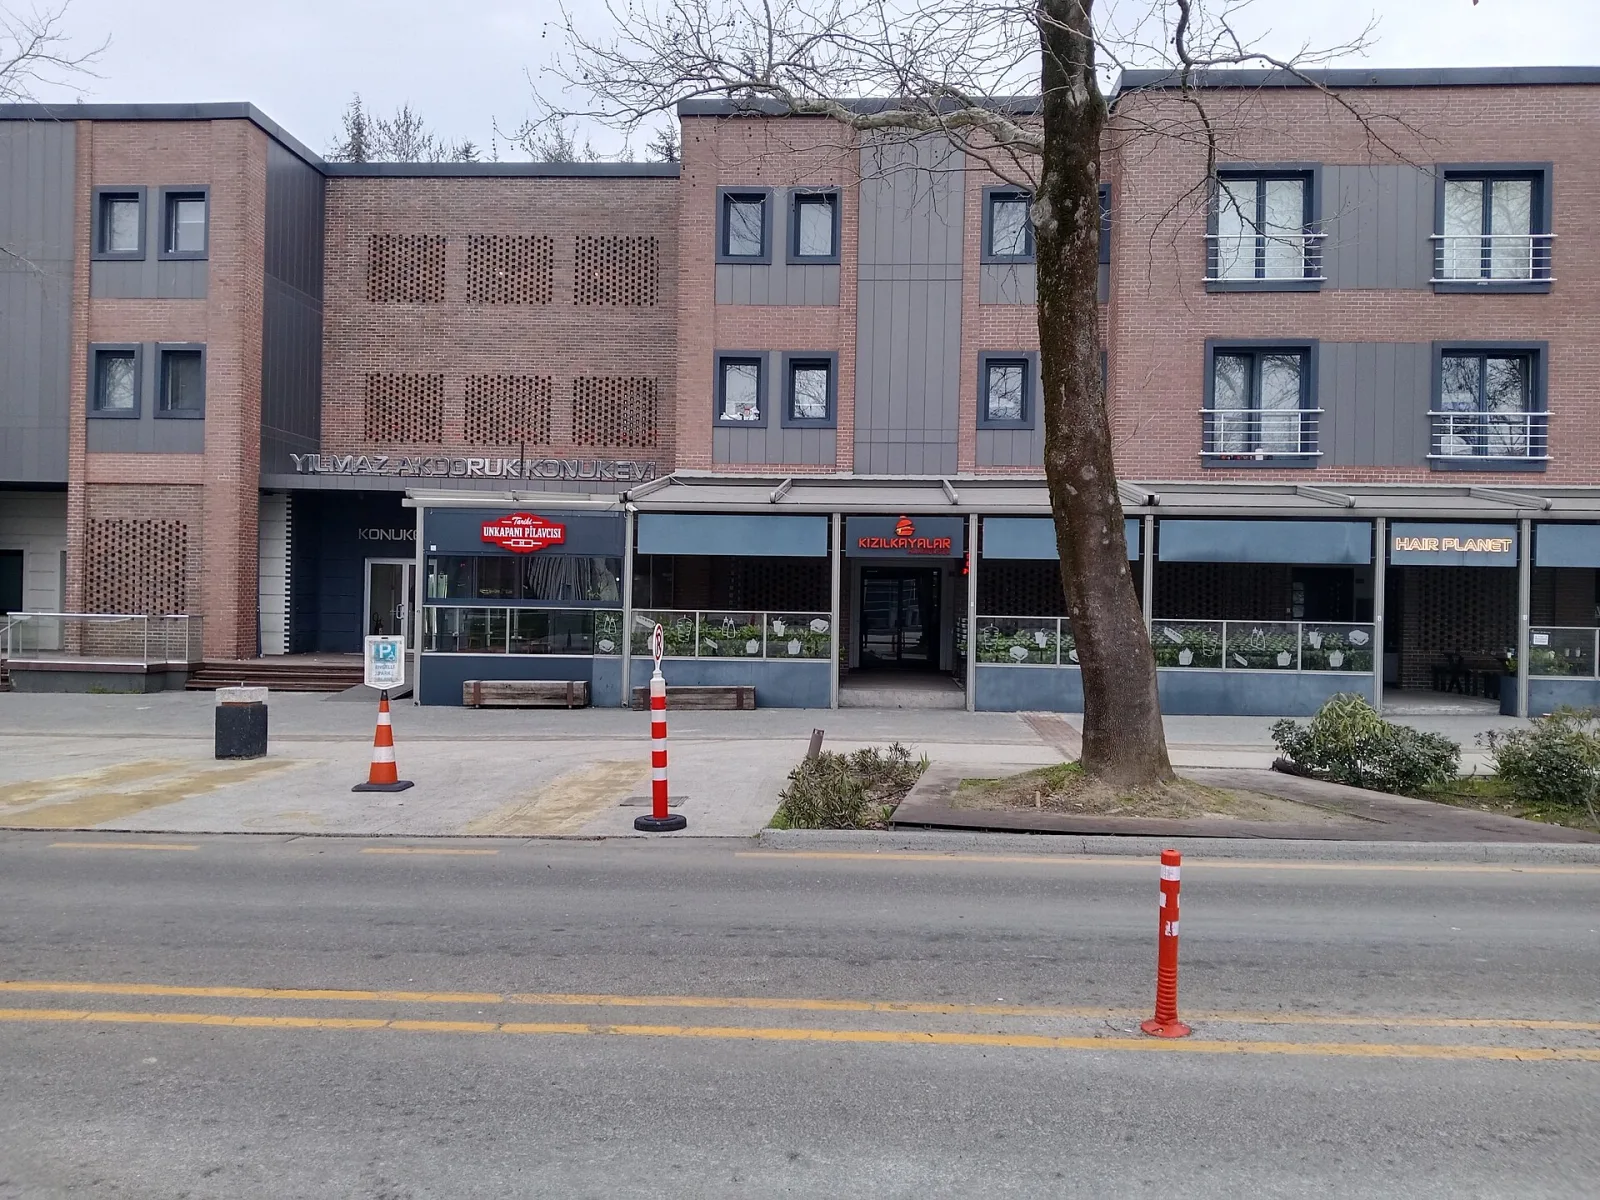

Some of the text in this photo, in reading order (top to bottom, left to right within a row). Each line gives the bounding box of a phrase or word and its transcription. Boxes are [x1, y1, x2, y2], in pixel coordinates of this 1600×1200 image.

[289, 453, 390, 473] YILMAZ
[483, 525, 562, 539] UNKAPANI PİLAVCISI
[858, 538, 951, 549] KIZILKAYALAR
[1395, 537, 1513, 552] HAIR PLANET
[379, 644, 392, 659] P
